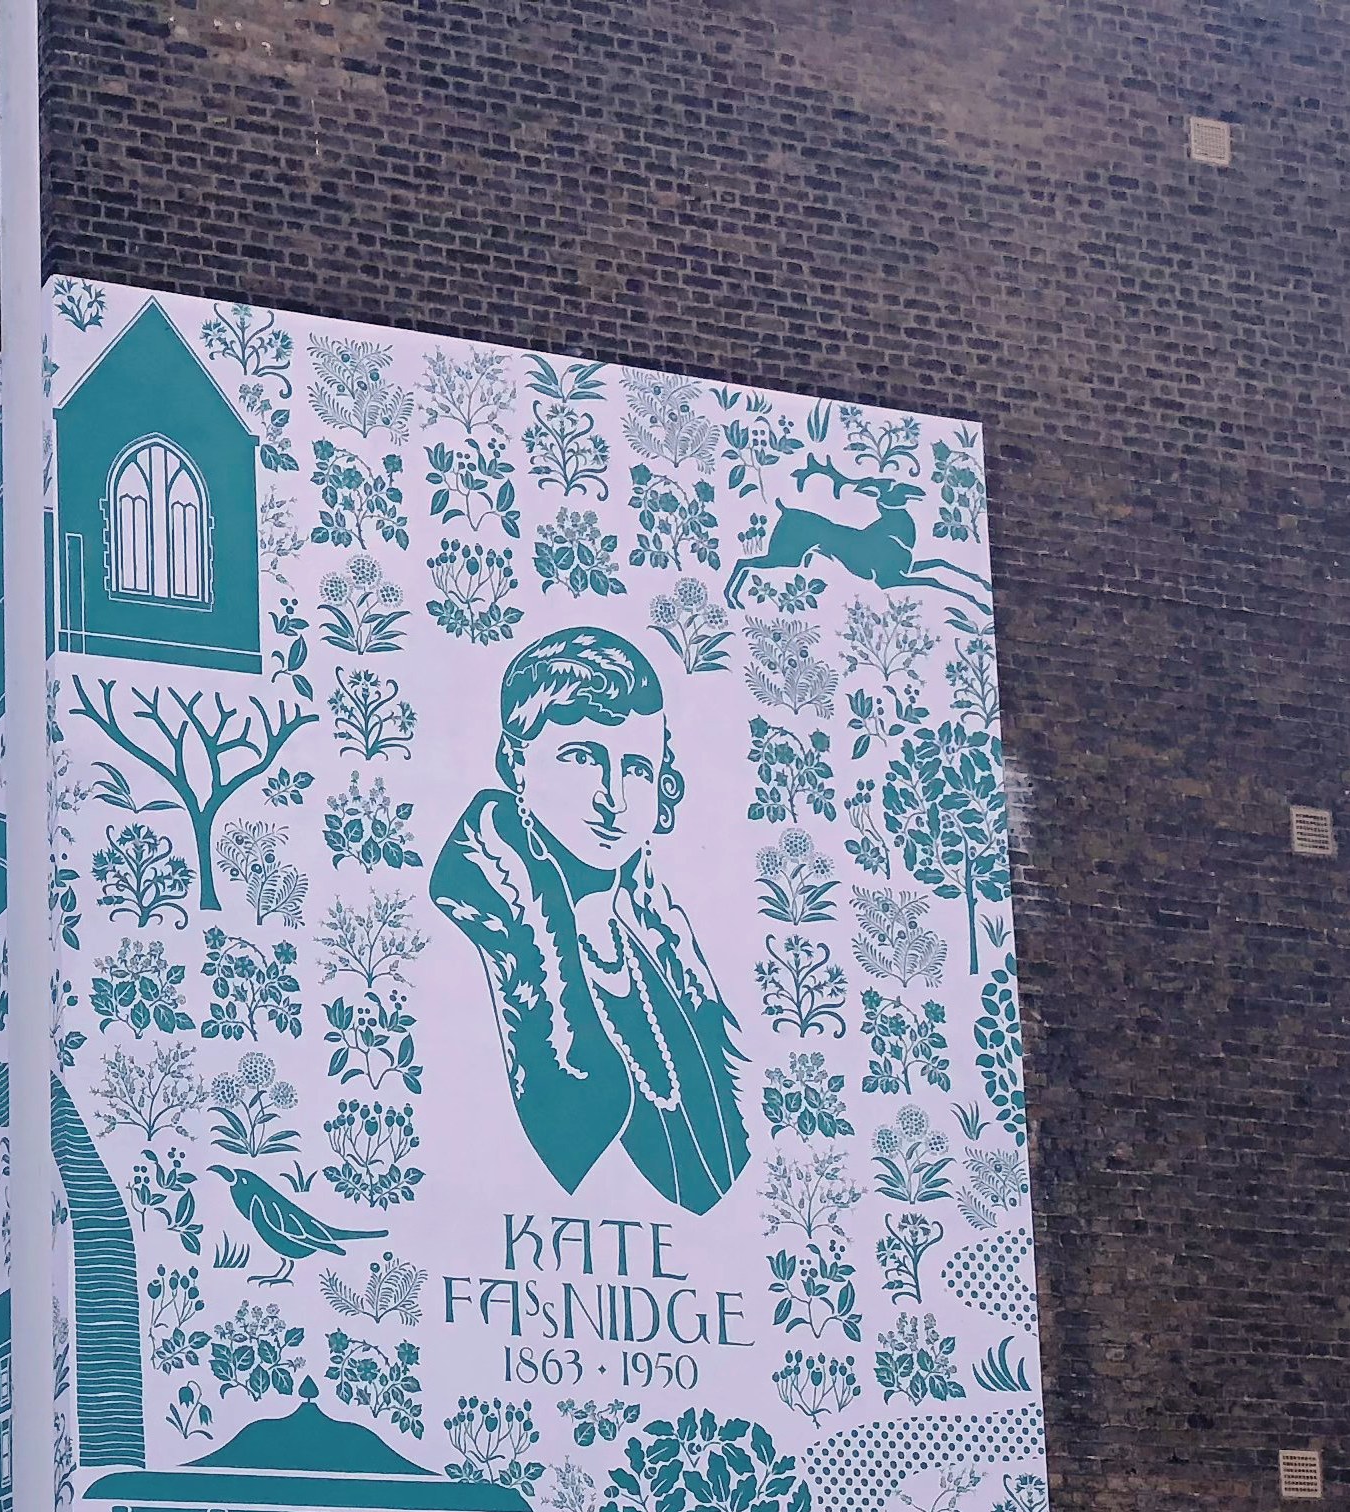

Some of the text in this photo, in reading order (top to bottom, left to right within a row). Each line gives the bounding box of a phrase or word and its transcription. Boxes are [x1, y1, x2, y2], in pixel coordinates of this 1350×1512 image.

[502, 1213, 689, 1281] KATE
[503, 1345, 699, 1390] 1863 1950
